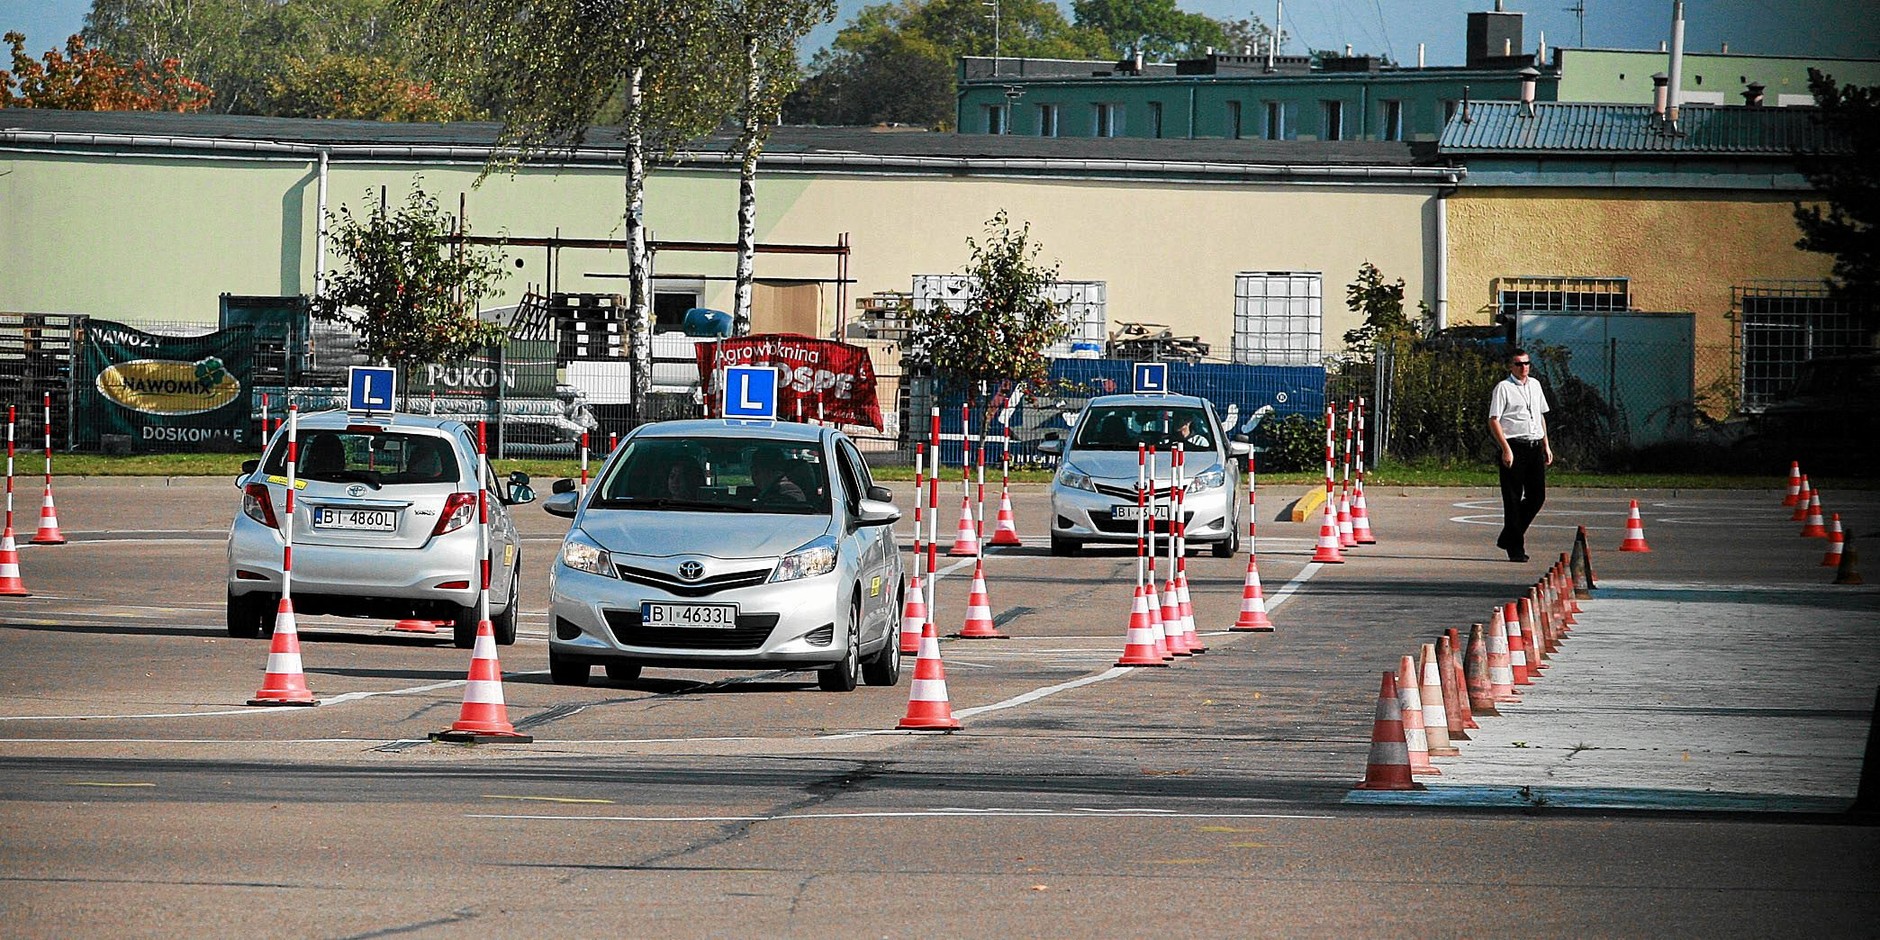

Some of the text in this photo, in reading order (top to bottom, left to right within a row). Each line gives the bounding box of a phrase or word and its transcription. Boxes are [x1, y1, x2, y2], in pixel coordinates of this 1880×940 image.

[90, 327, 160, 348] NAWOZY
[123, 376, 212, 394] NAWOMIX
[427, 362, 516, 388] POKON
[1143, 368, 1158, 388] L
[363, 374, 384, 405] L
[740, 374, 763, 410] L
[323, 509, 392, 527] BI 4860L
[1118, 507, 1131, 518] BI
[652, 606, 732, 624] BI 4633L
